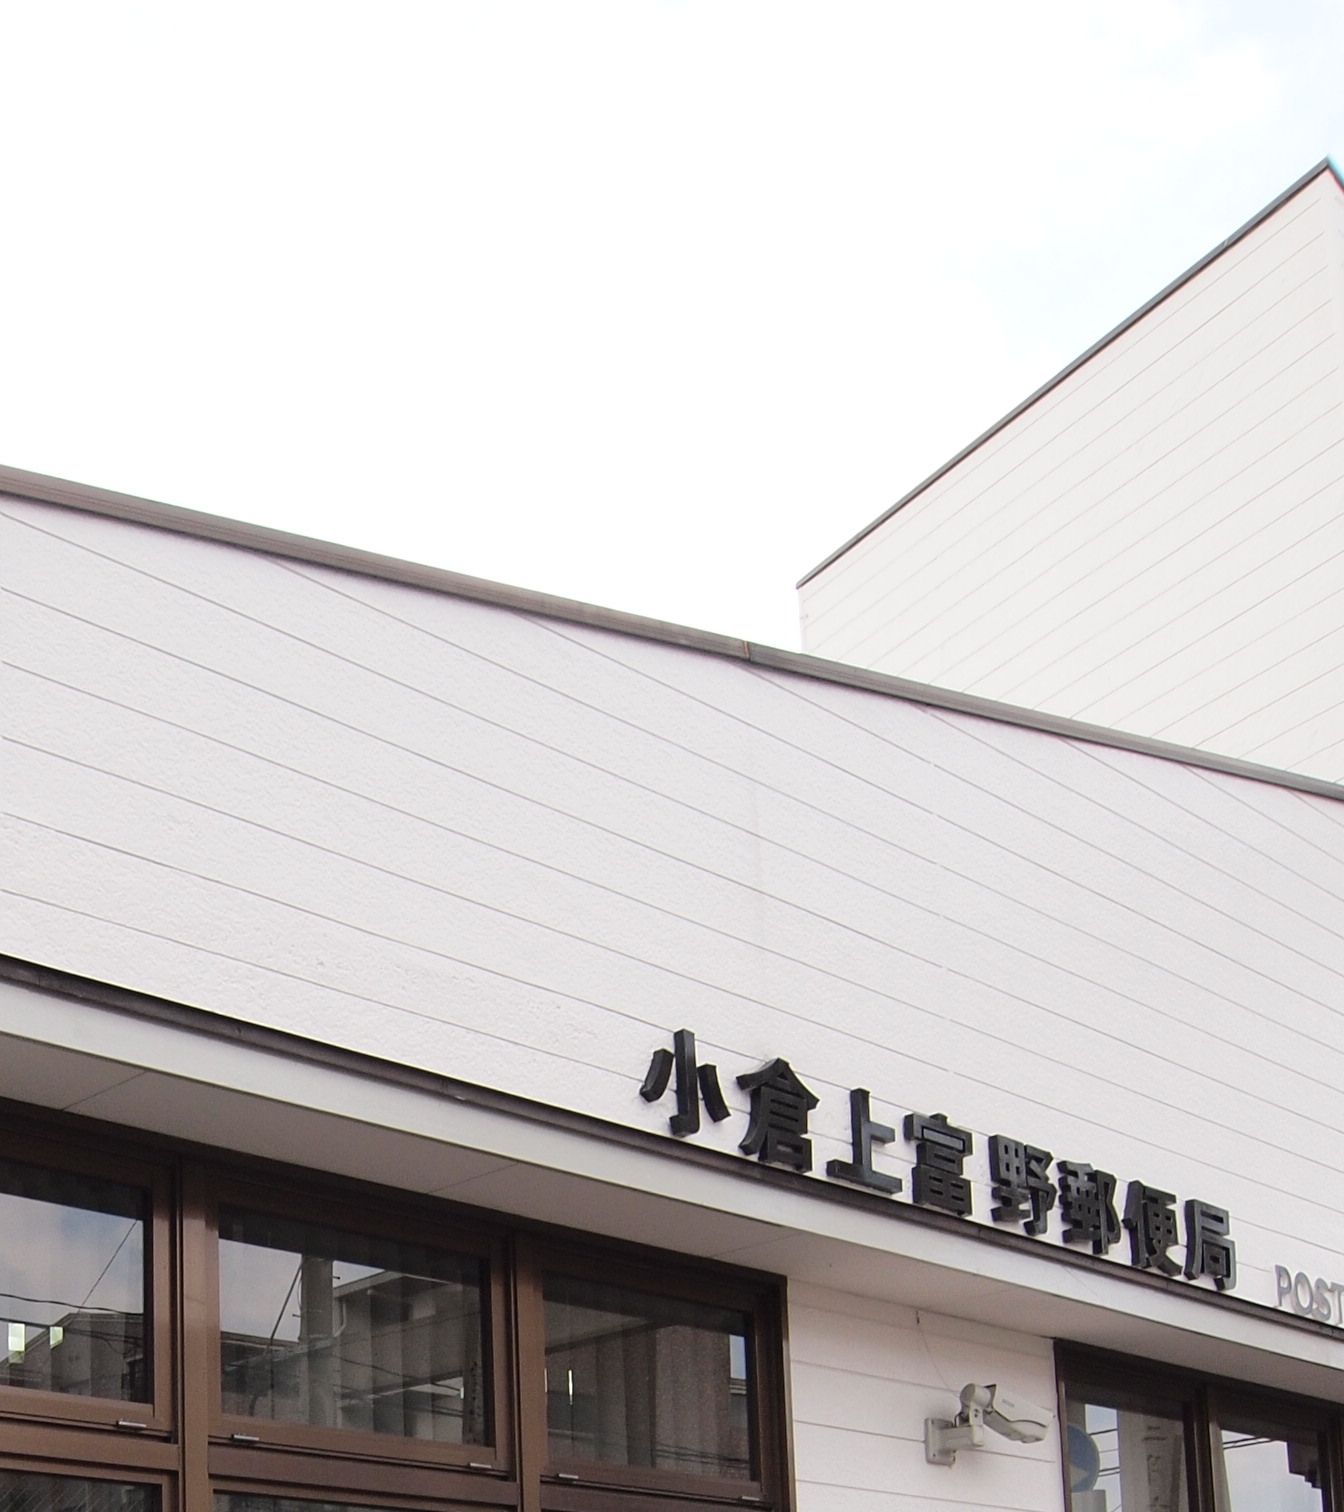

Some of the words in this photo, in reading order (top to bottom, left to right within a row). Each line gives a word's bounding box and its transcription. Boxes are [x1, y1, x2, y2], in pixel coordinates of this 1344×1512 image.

[639, 1028, 1238, 1290] 小倉上富野郵便局
[1274, 1264, 1344, 1325] POST
